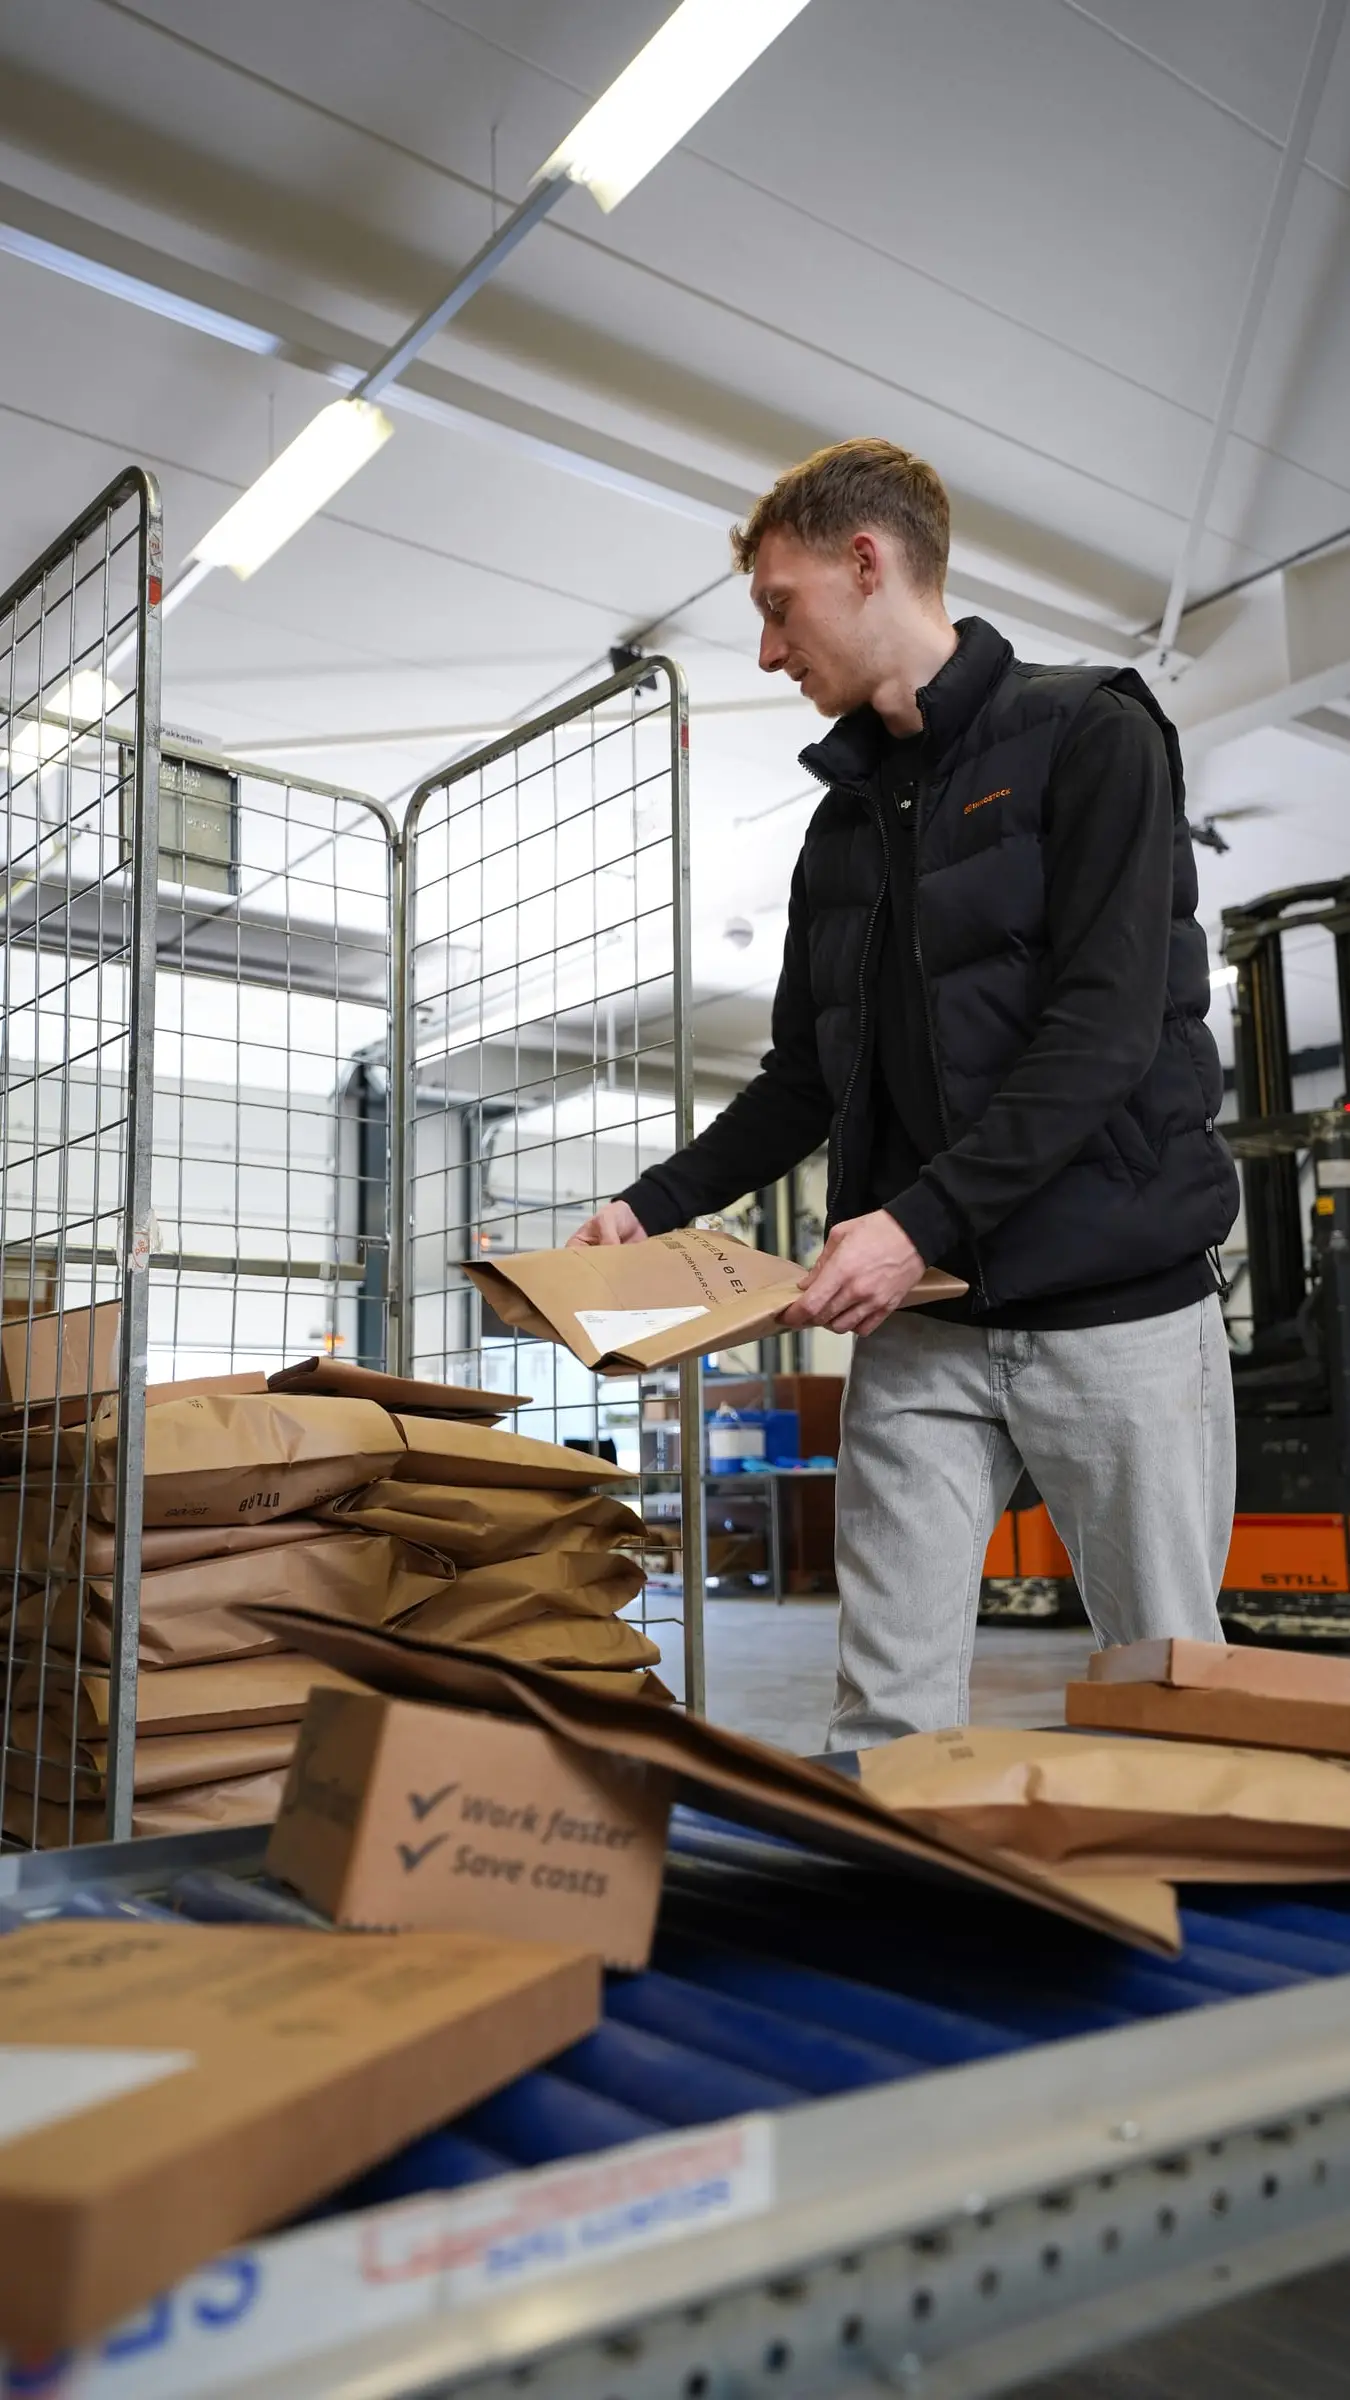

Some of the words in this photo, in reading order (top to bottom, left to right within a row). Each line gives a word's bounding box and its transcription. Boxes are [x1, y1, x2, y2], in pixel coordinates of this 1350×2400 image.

[1260, 1573, 1338, 1587] STILL
[460, 1795, 540, 1834] Work
[540, 1807, 637, 1848] faster
[450, 1844, 526, 1885] Save
[529, 1863, 610, 1898] costs
